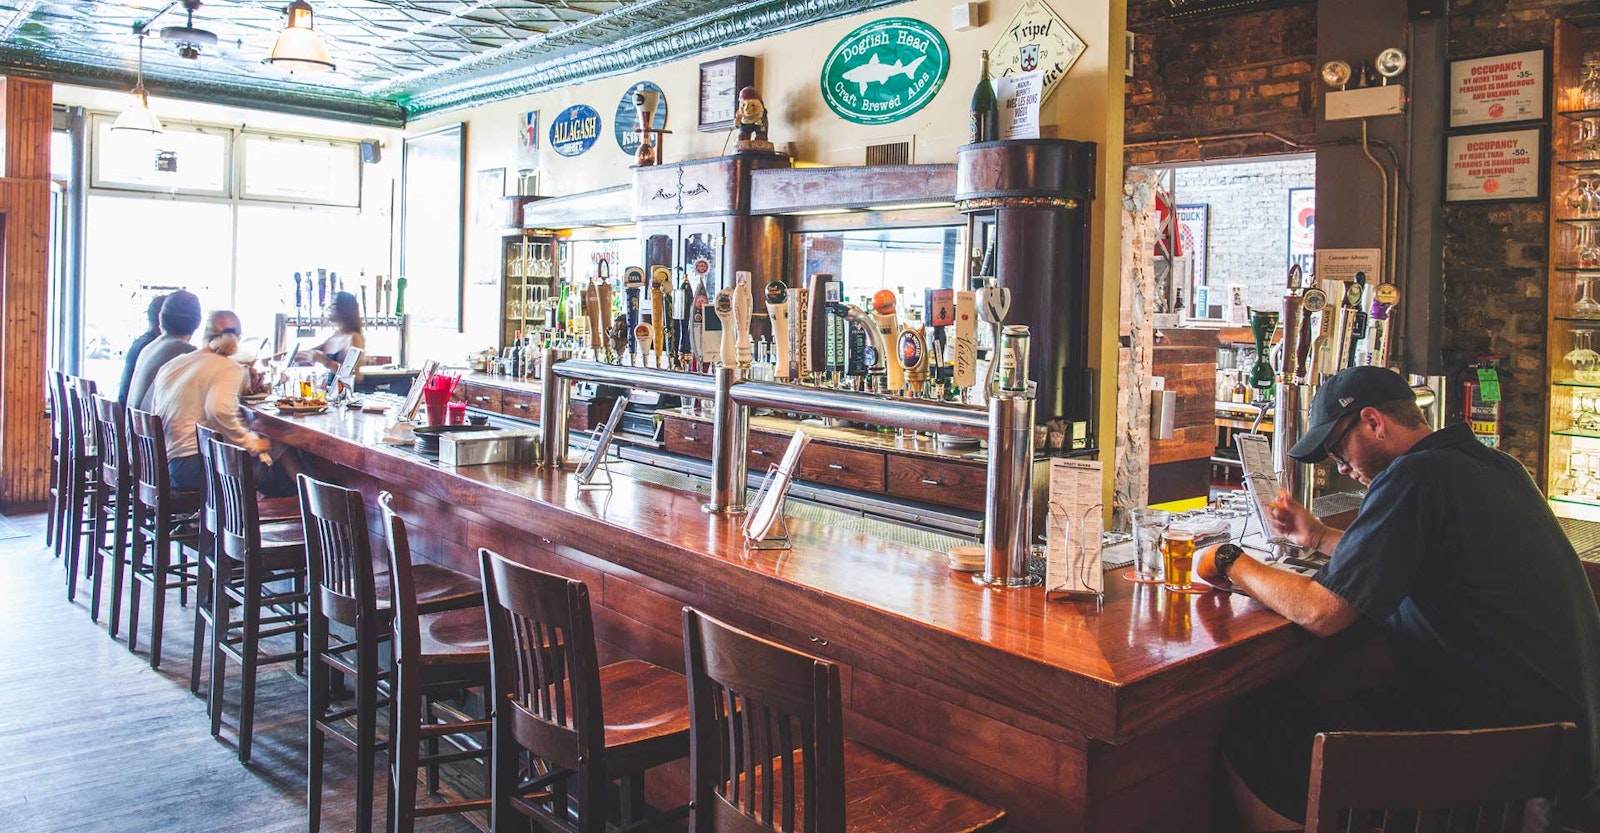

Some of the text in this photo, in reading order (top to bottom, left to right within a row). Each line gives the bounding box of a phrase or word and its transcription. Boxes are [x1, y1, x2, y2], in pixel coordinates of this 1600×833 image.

[1009, 18, 1053, 43] Tripel
[842, 31, 930, 63] Dogfish Head
[1012, 50, 1048, 65] 16 79
[1471, 61, 1522, 76] OCCUPANCY
[1459, 84, 1487, 93] PERSONS
[1496, 79, 1535, 89] DANGEROUS
[1473, 76, 1490, 84] MORE
[835, 72, 930, 111] Craft Brewed Ales
[1026, 94, 1038, 104] BONS
[1473, 89, 1520, 100] AND UNLAWFUL
[554, 117, 597, 144] ALLAGASH
[1467, 140, 1518, 151] OCCUPANCY
[1454, 161, 1482, 169] PERSONS
[1491, 157, 1530, 166] DANGEROUS
[1482, 167, 1515, 175] UNLAWFUL
[799, 292, 808, 334] HALF
[957, 333, 972, 377] Virtue
